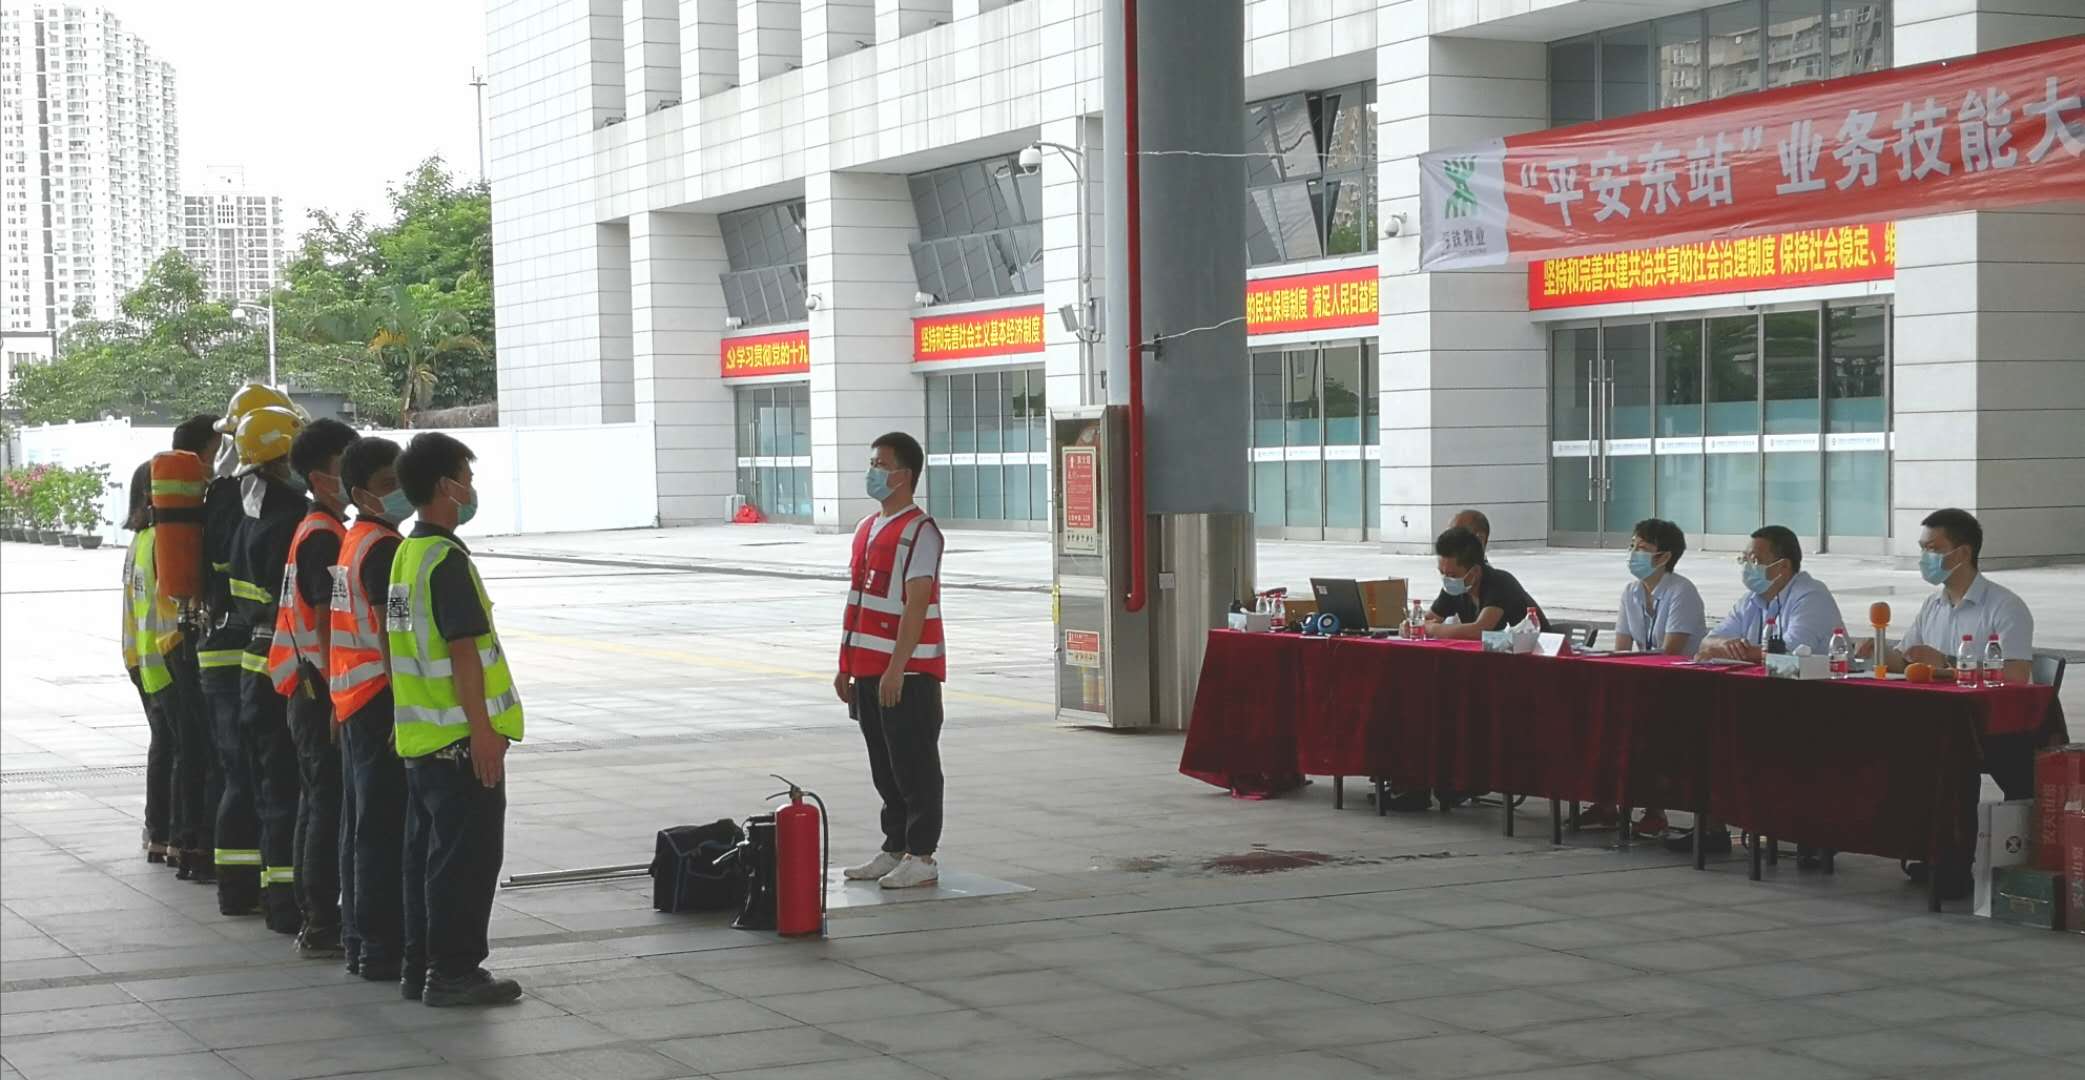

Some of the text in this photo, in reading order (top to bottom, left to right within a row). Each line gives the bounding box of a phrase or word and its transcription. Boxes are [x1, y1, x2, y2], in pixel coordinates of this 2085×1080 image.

[1544, 234, 1776, 296] 坚持和完善共建共治共享的社会治理制度
[921, 316, 1041, 353] 坚持和完善社会主义基本经济制度
